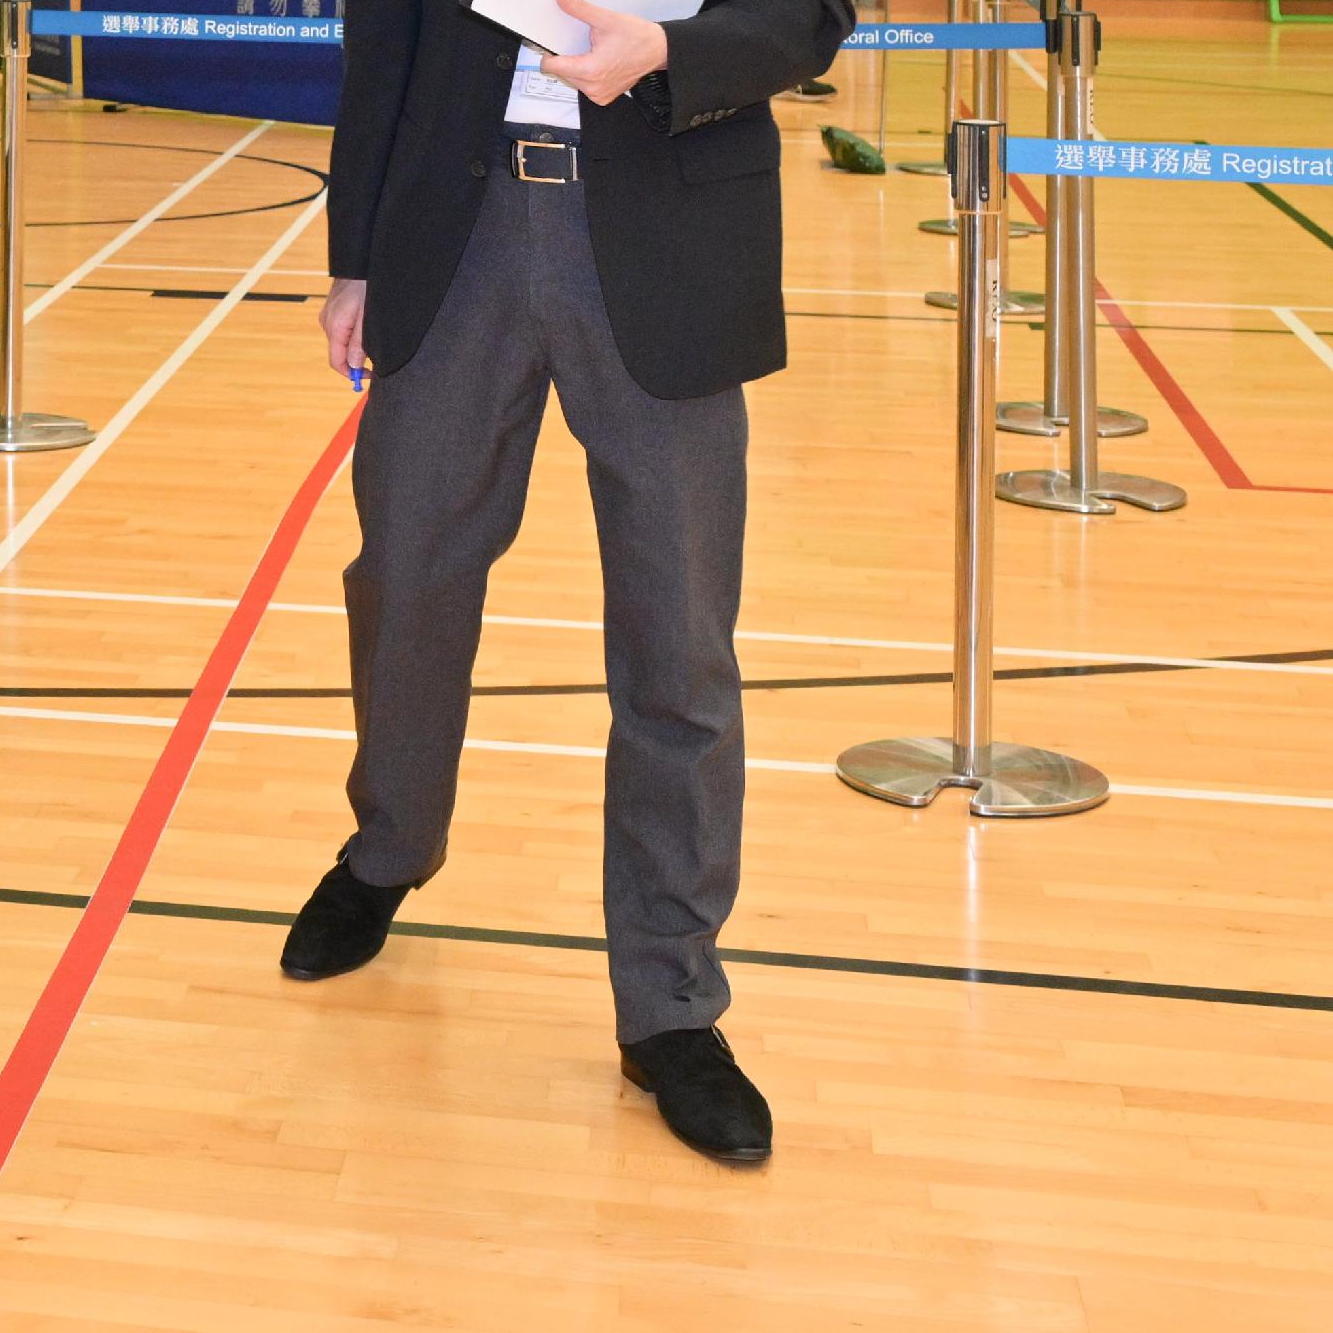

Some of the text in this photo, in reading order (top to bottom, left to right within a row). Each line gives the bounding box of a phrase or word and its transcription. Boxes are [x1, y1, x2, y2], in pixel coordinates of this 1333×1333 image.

[102, 14, 199, 35] 選舉事務處
[205, 20, 295, 39] Registration
[300, 22, 329, 38] and
[884, 29, 935, 44] Office
[1054, 143, 1212, 175] 選舉事務處
